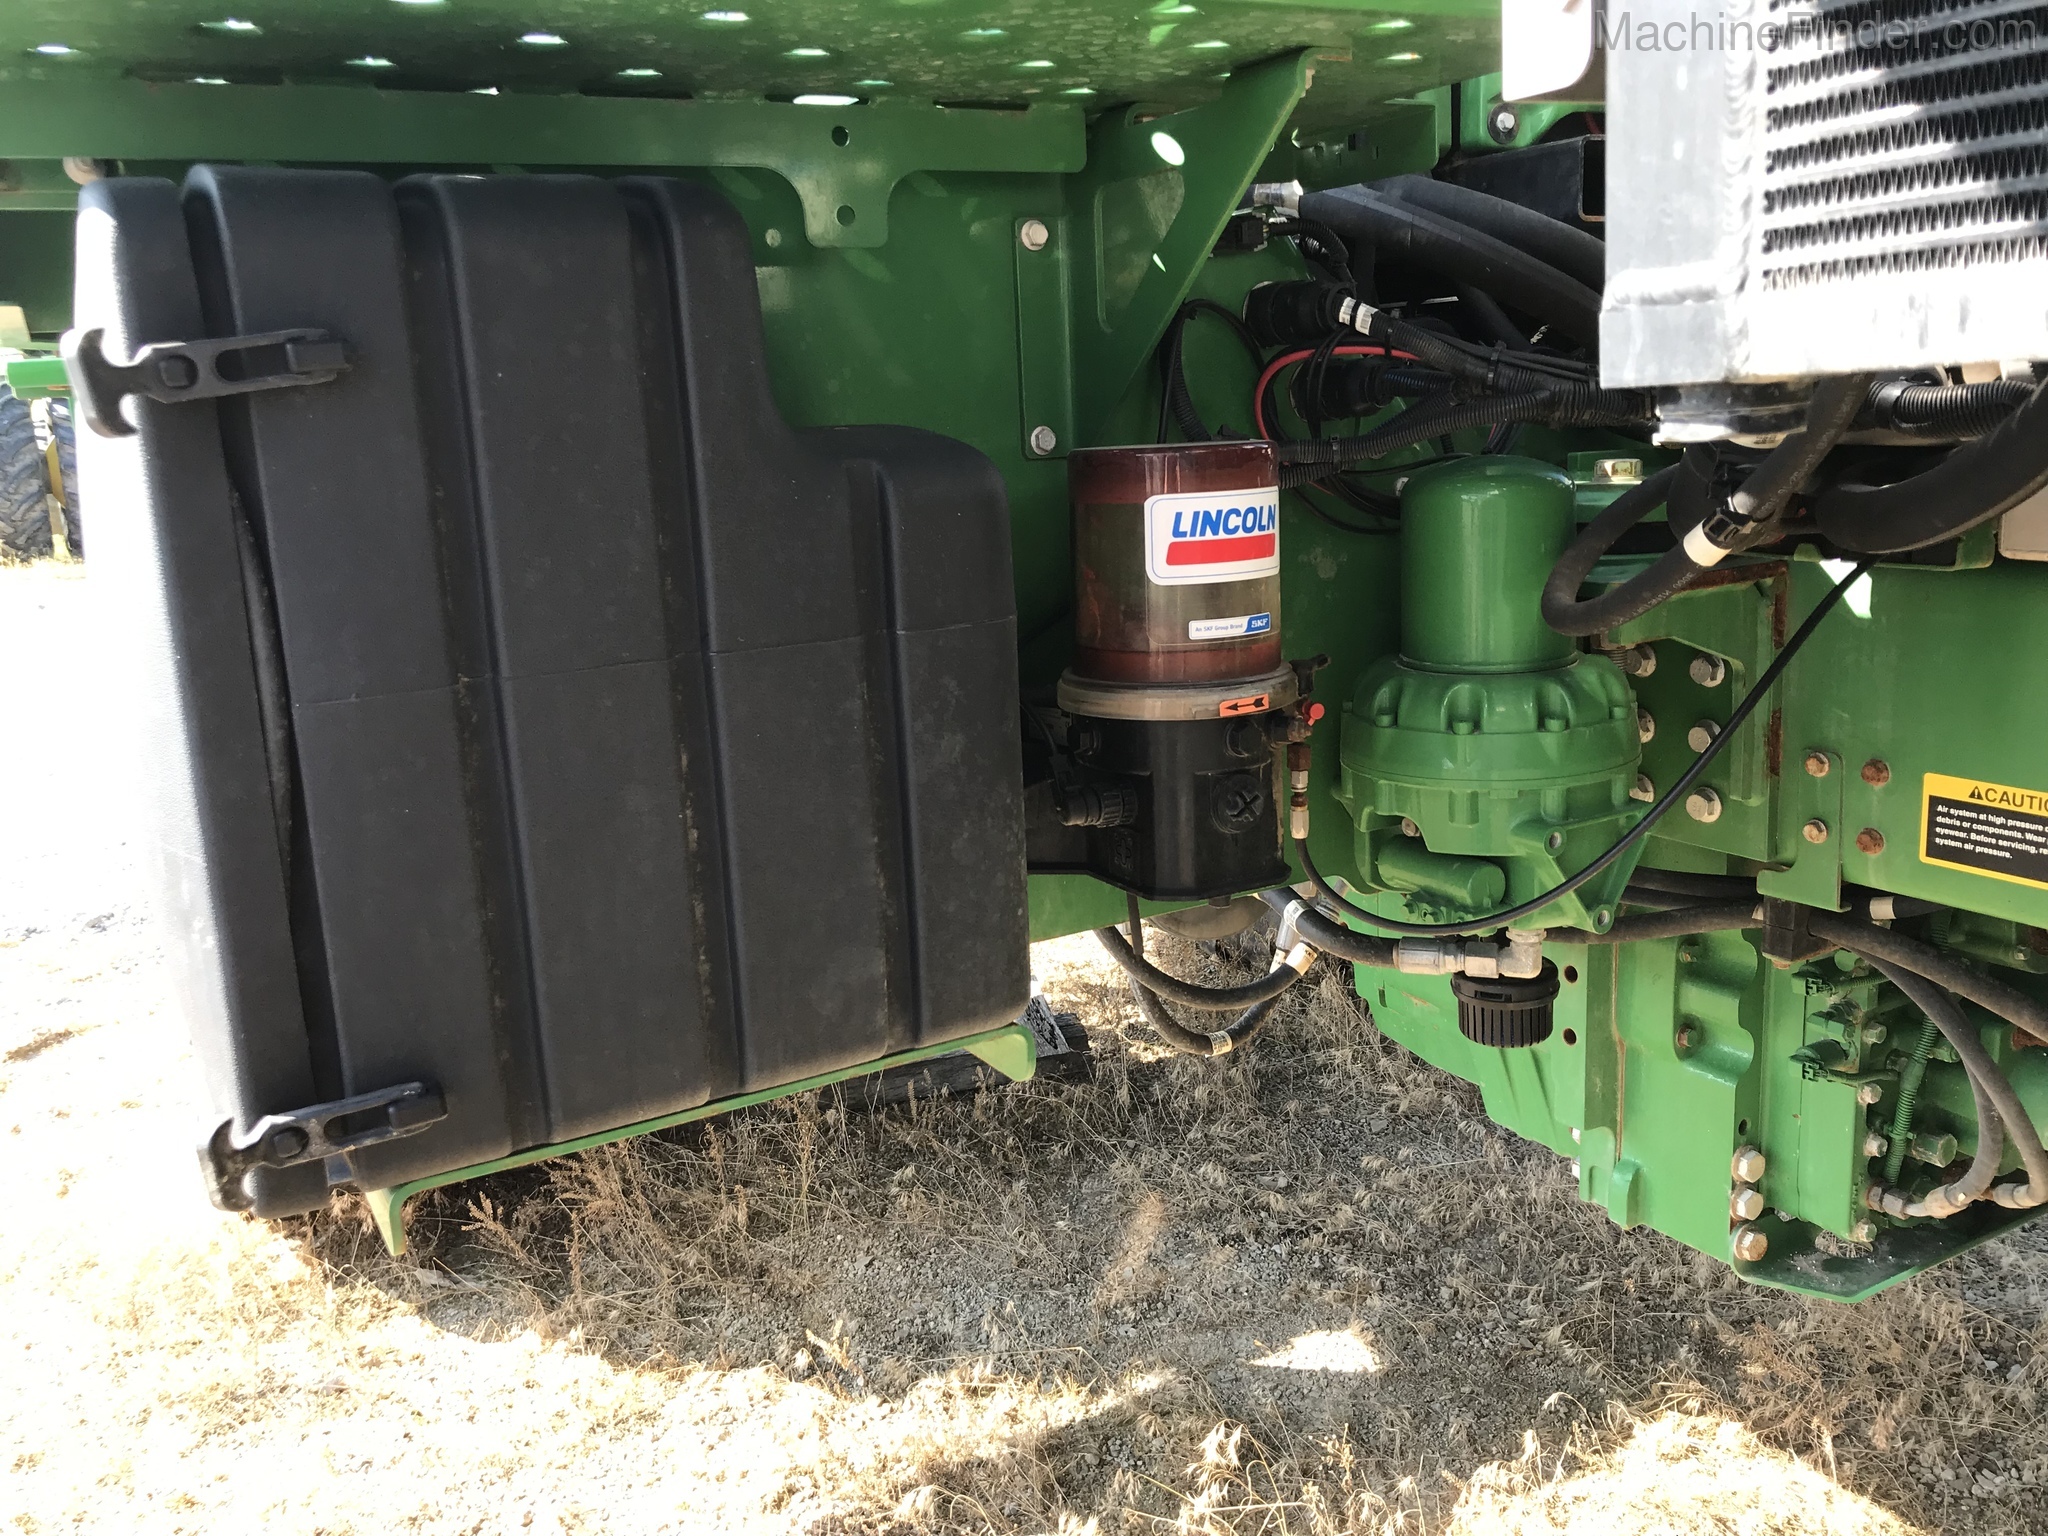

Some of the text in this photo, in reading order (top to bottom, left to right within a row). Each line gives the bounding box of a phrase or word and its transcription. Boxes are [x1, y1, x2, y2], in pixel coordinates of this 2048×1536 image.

[1172, 504, 1277, 538] LINCOLN
[1251, 618, 1268, 628] SKF
[1936, 816, 2047, 844] debris or components. Wear
[1937, 804, 1949, 813] Air
[1949, 806, 1977, 819] system
[1978, 813, 1988, 821] at
[1987, 813, 2007, 825] high
[2006, 819, 2044, 832] pressure
[1935, 826, 1969, 839] eyewear.
[1969, 832, 1997, 845] Before
[1935, 837, 2013, 859] system air pressure.
